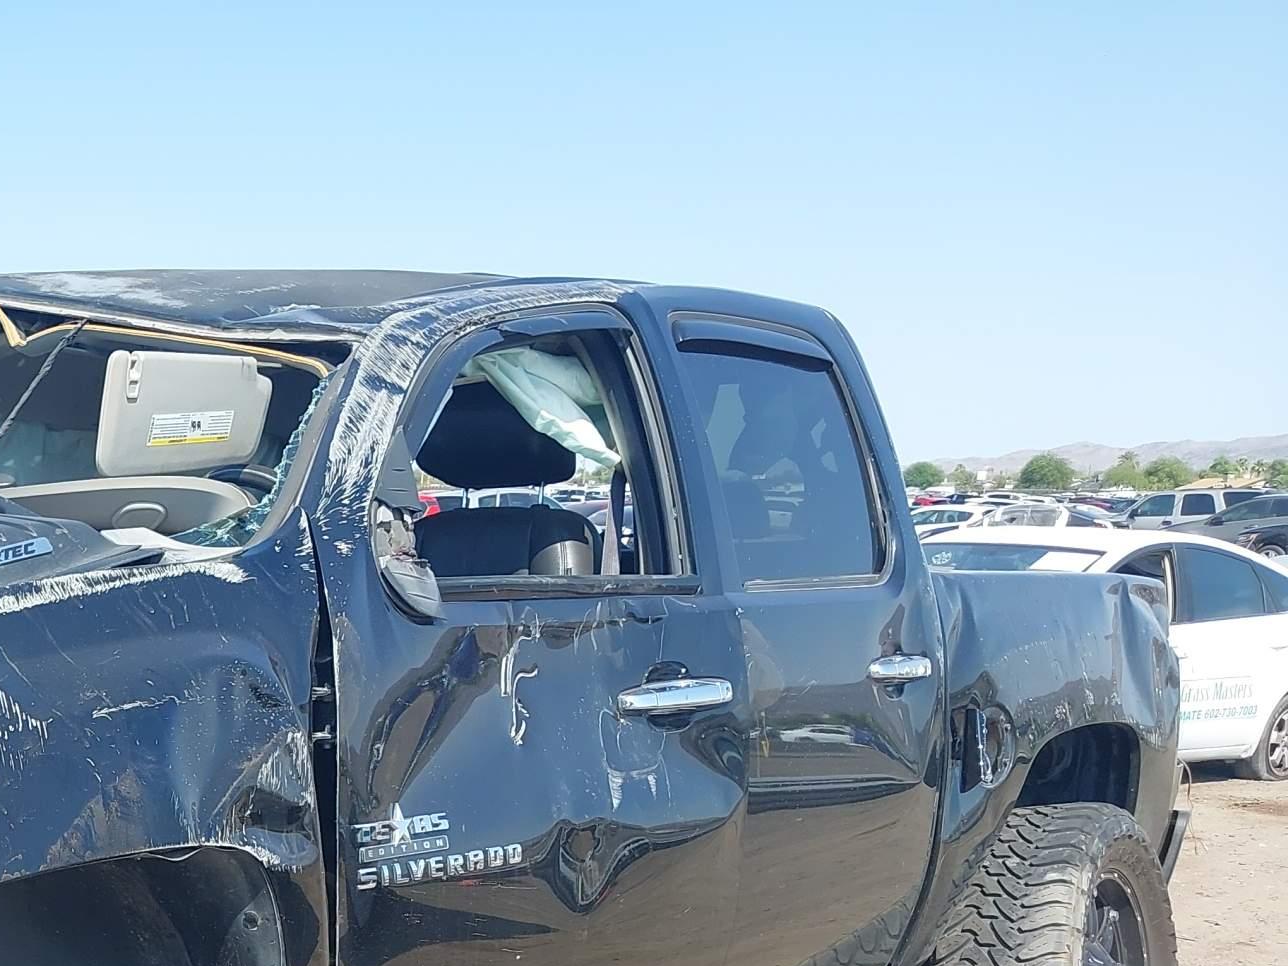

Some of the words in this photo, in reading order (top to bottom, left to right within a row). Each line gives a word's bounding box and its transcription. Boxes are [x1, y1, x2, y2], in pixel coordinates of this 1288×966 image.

[353, 803, 450, 846] TEXAS
[356, 843, 523, 891] SILVERADO
[367, 838, 445, 859] EDITION
